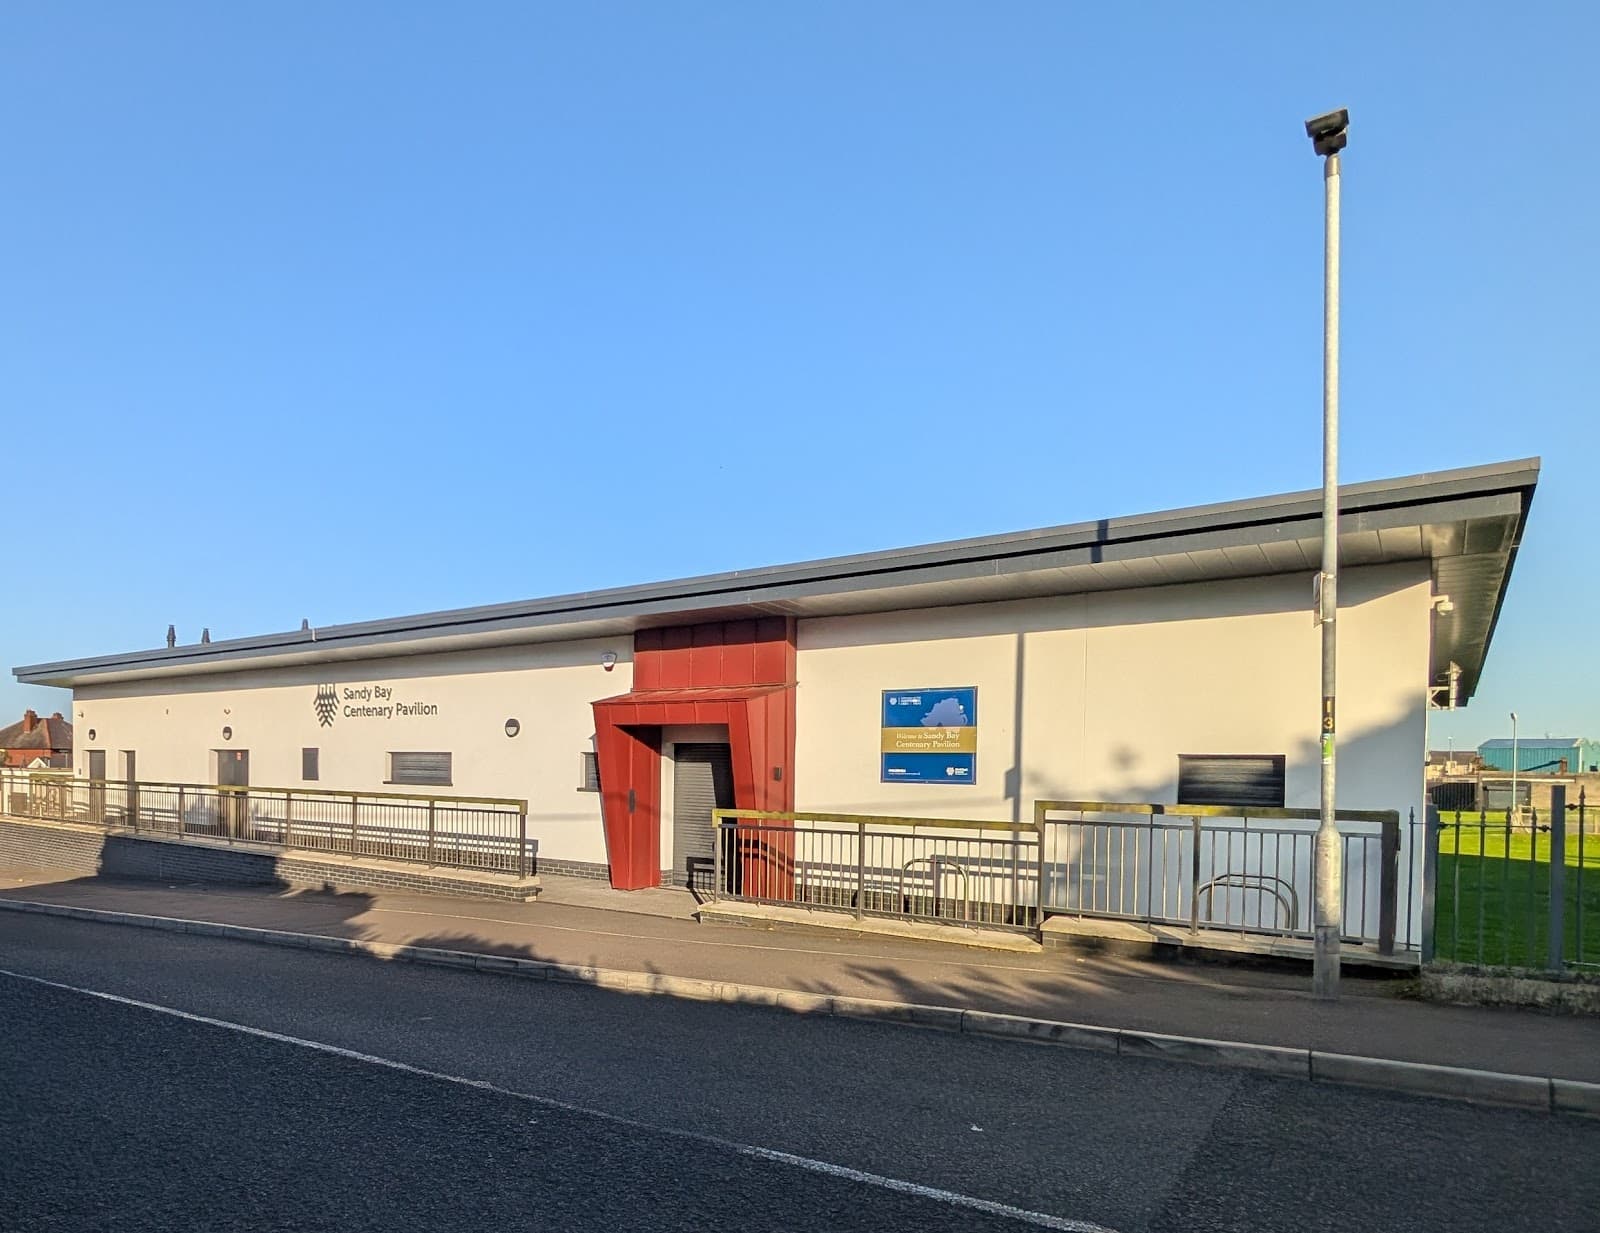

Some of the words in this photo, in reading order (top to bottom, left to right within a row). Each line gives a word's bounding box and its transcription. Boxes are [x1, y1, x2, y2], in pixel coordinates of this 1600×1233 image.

[343, 686, 372, 702] Sandy
[374, 685, 393, 701] Bay
[343, 704, 394, 719] Centenary
[396, 702, 438, 716] Pavilion
[923, 731, 945, 740] Sandy
[946, 731, 960, 740] Bay
[895, 740, 931, 749] Centenary
[932, 740, 961, 748] Pavilion
